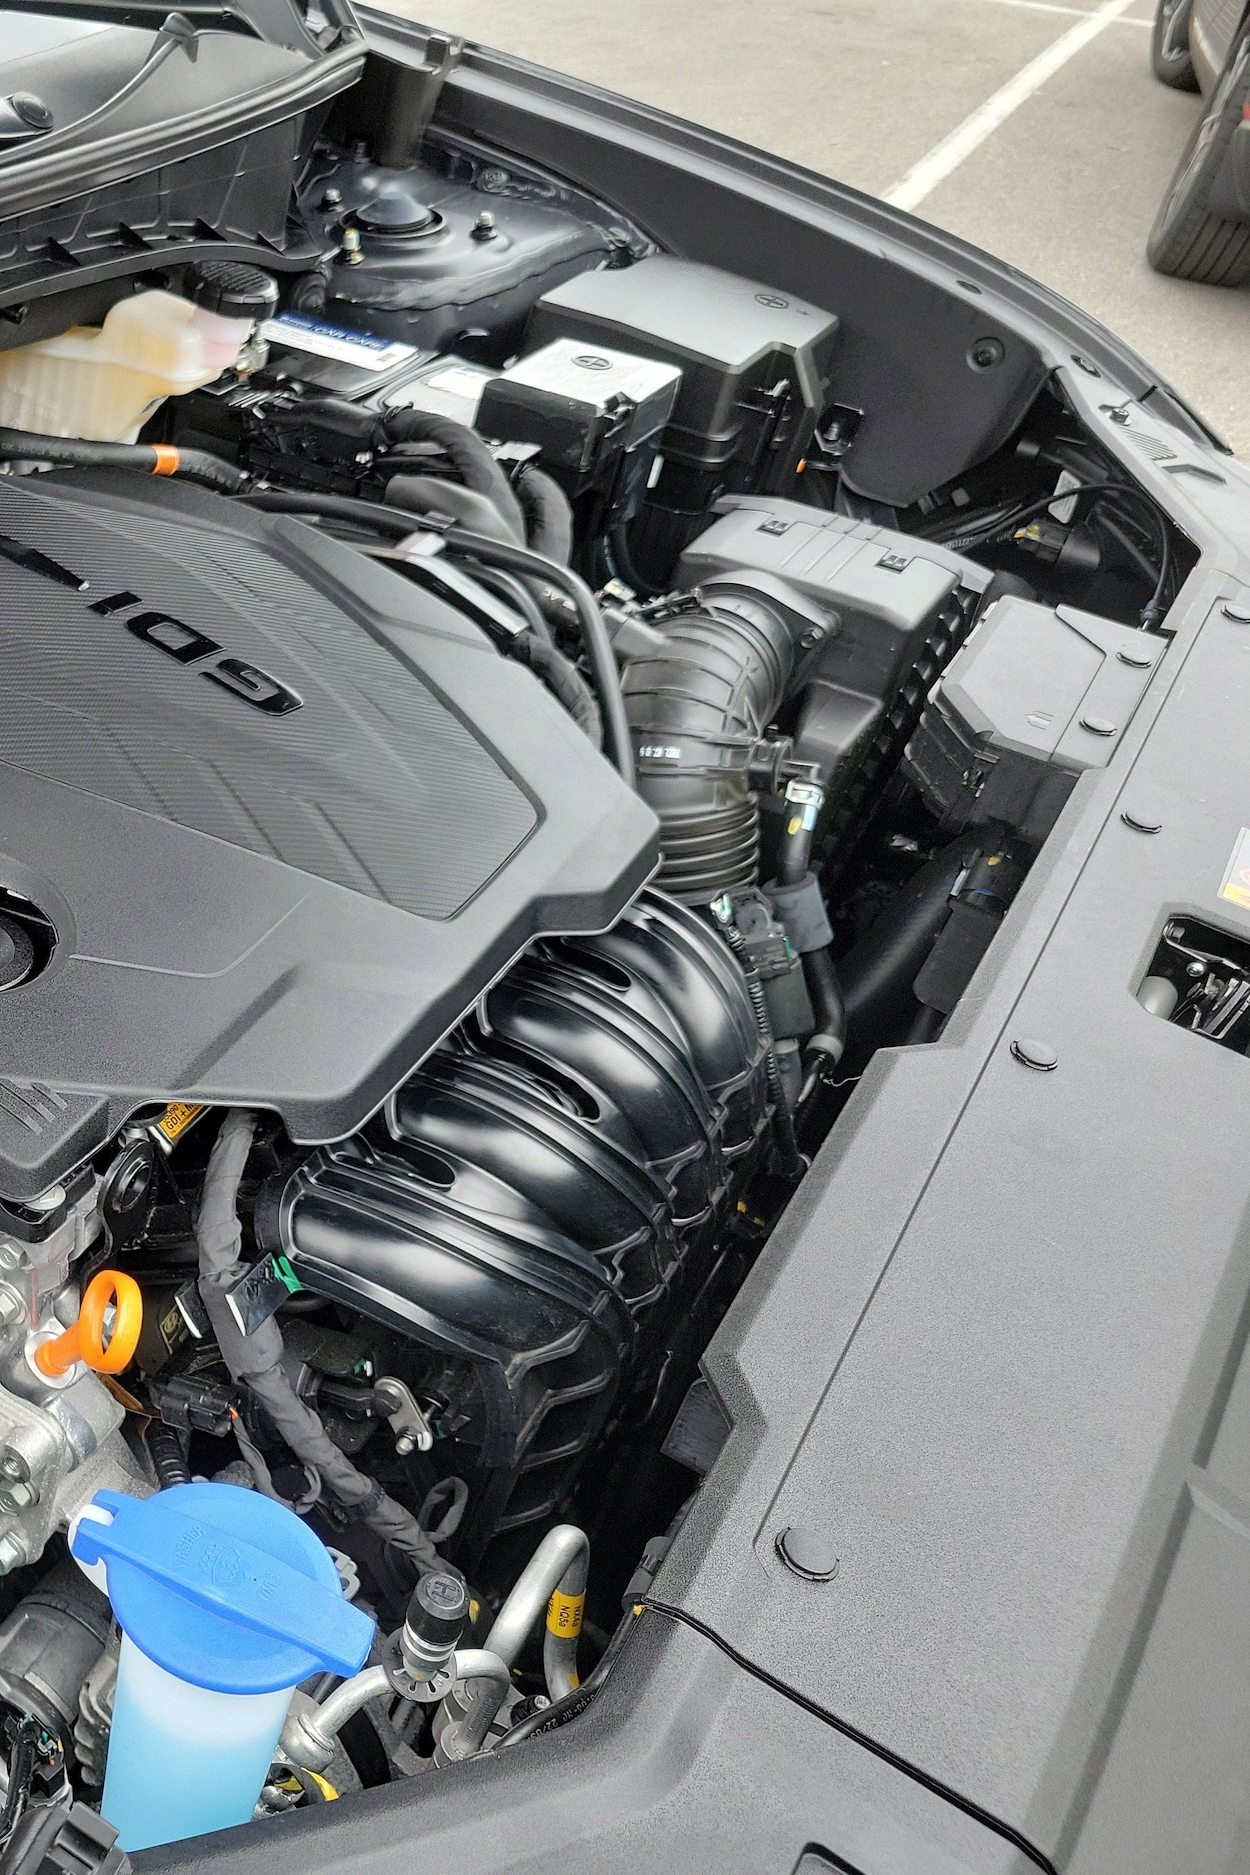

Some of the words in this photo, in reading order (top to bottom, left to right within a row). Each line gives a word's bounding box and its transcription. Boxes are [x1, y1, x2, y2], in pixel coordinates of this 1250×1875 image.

[88, 592, 304, 717] GDI
[166, 1113, 181, 1130] GDI
[174, 1524, 207, 1569] WASHER
[559, 1605, 570, 1627] NQ5a
